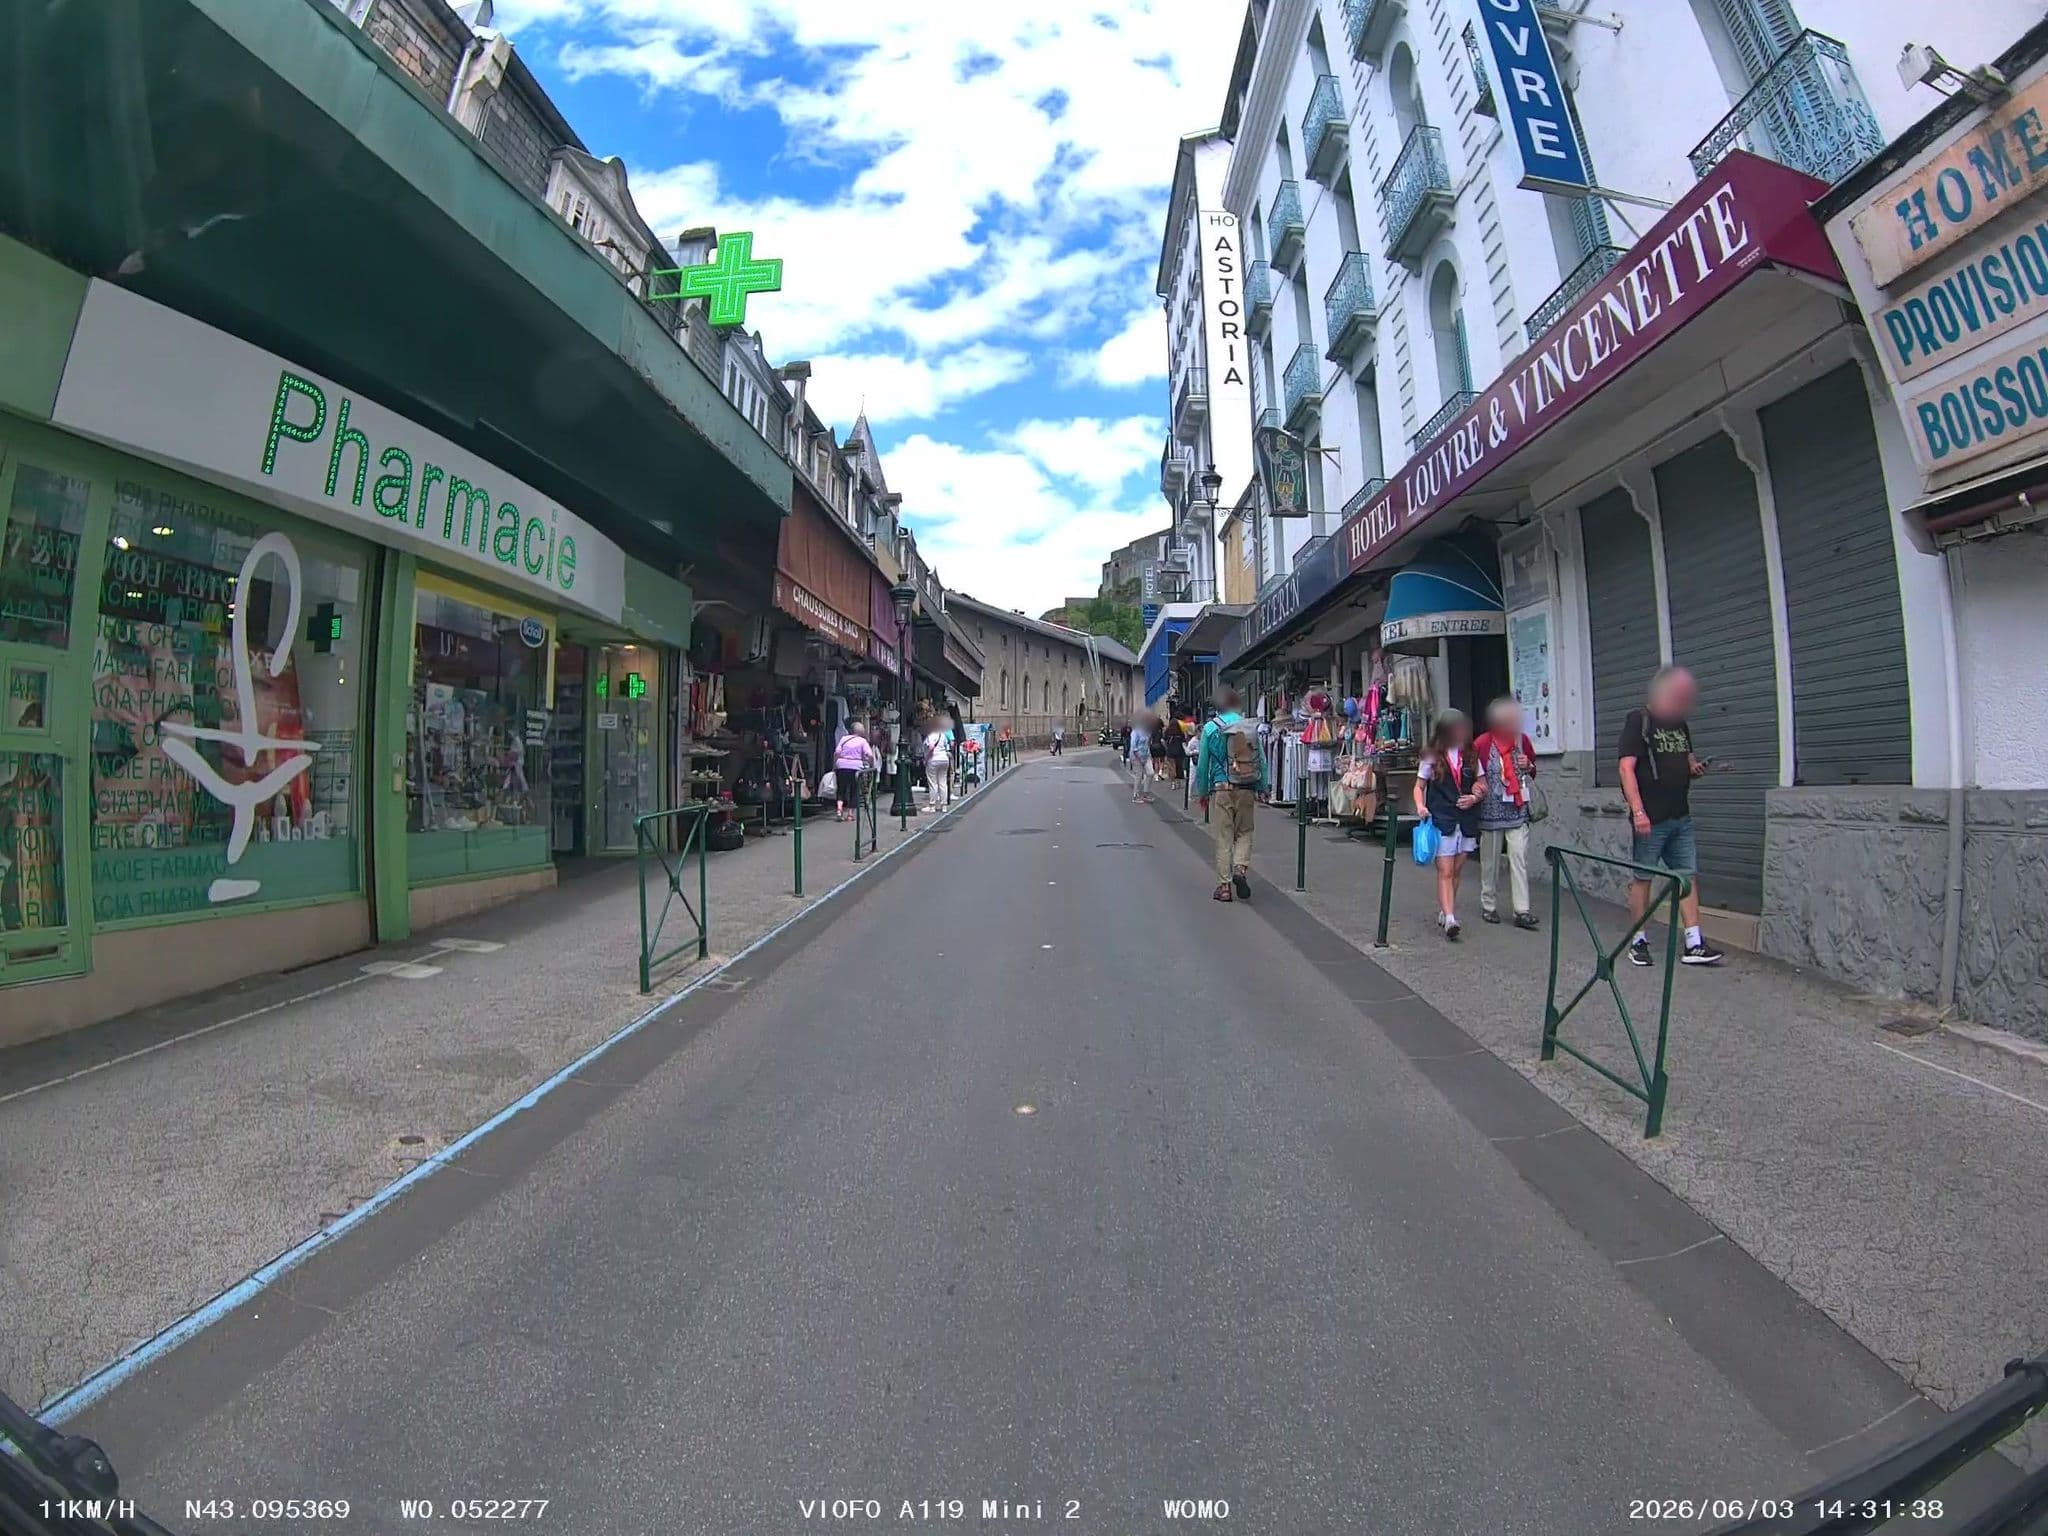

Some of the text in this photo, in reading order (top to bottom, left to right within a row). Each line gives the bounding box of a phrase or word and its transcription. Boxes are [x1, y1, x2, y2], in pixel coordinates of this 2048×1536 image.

[1895, 107, 2048, 250] HOME
[1214, 235, 1244, 386] ASTORIA
[1350, 182, 1749, 560] HOTEL LOUVRE & VINCENETTE
[261, 370, 578, 591] Pharmacie
